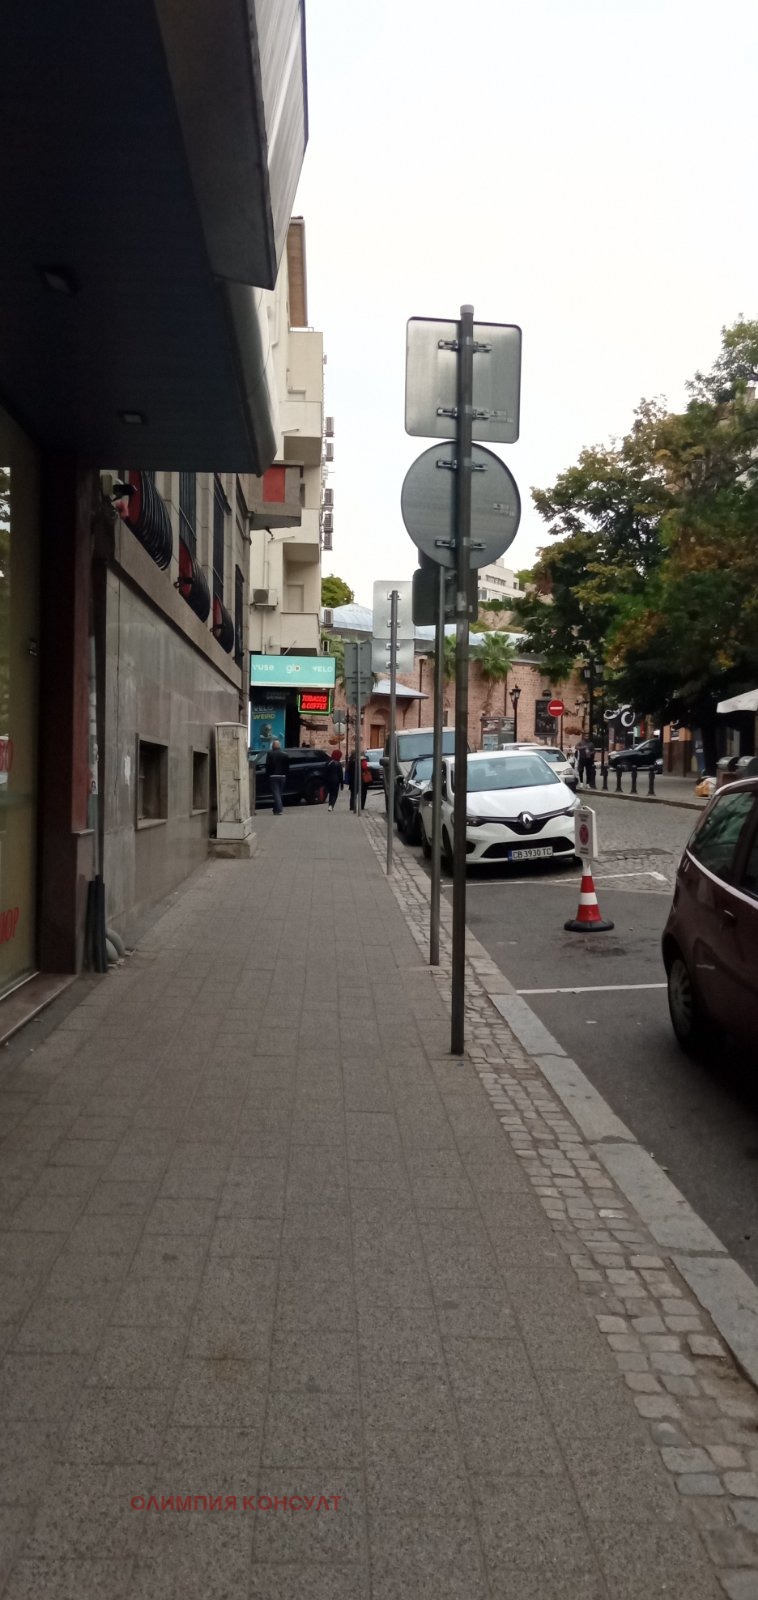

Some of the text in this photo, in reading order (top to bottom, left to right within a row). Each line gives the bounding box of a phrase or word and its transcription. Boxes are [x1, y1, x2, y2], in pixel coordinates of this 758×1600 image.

[286, 663, 301, 674] glo
[312, 665, 334, 673] VELO
[302, 694, 327, 703] TOBACCO
[306, 702, 327, 710] COFFEE
[512, 847, 552, 859] CB 3930 TC
